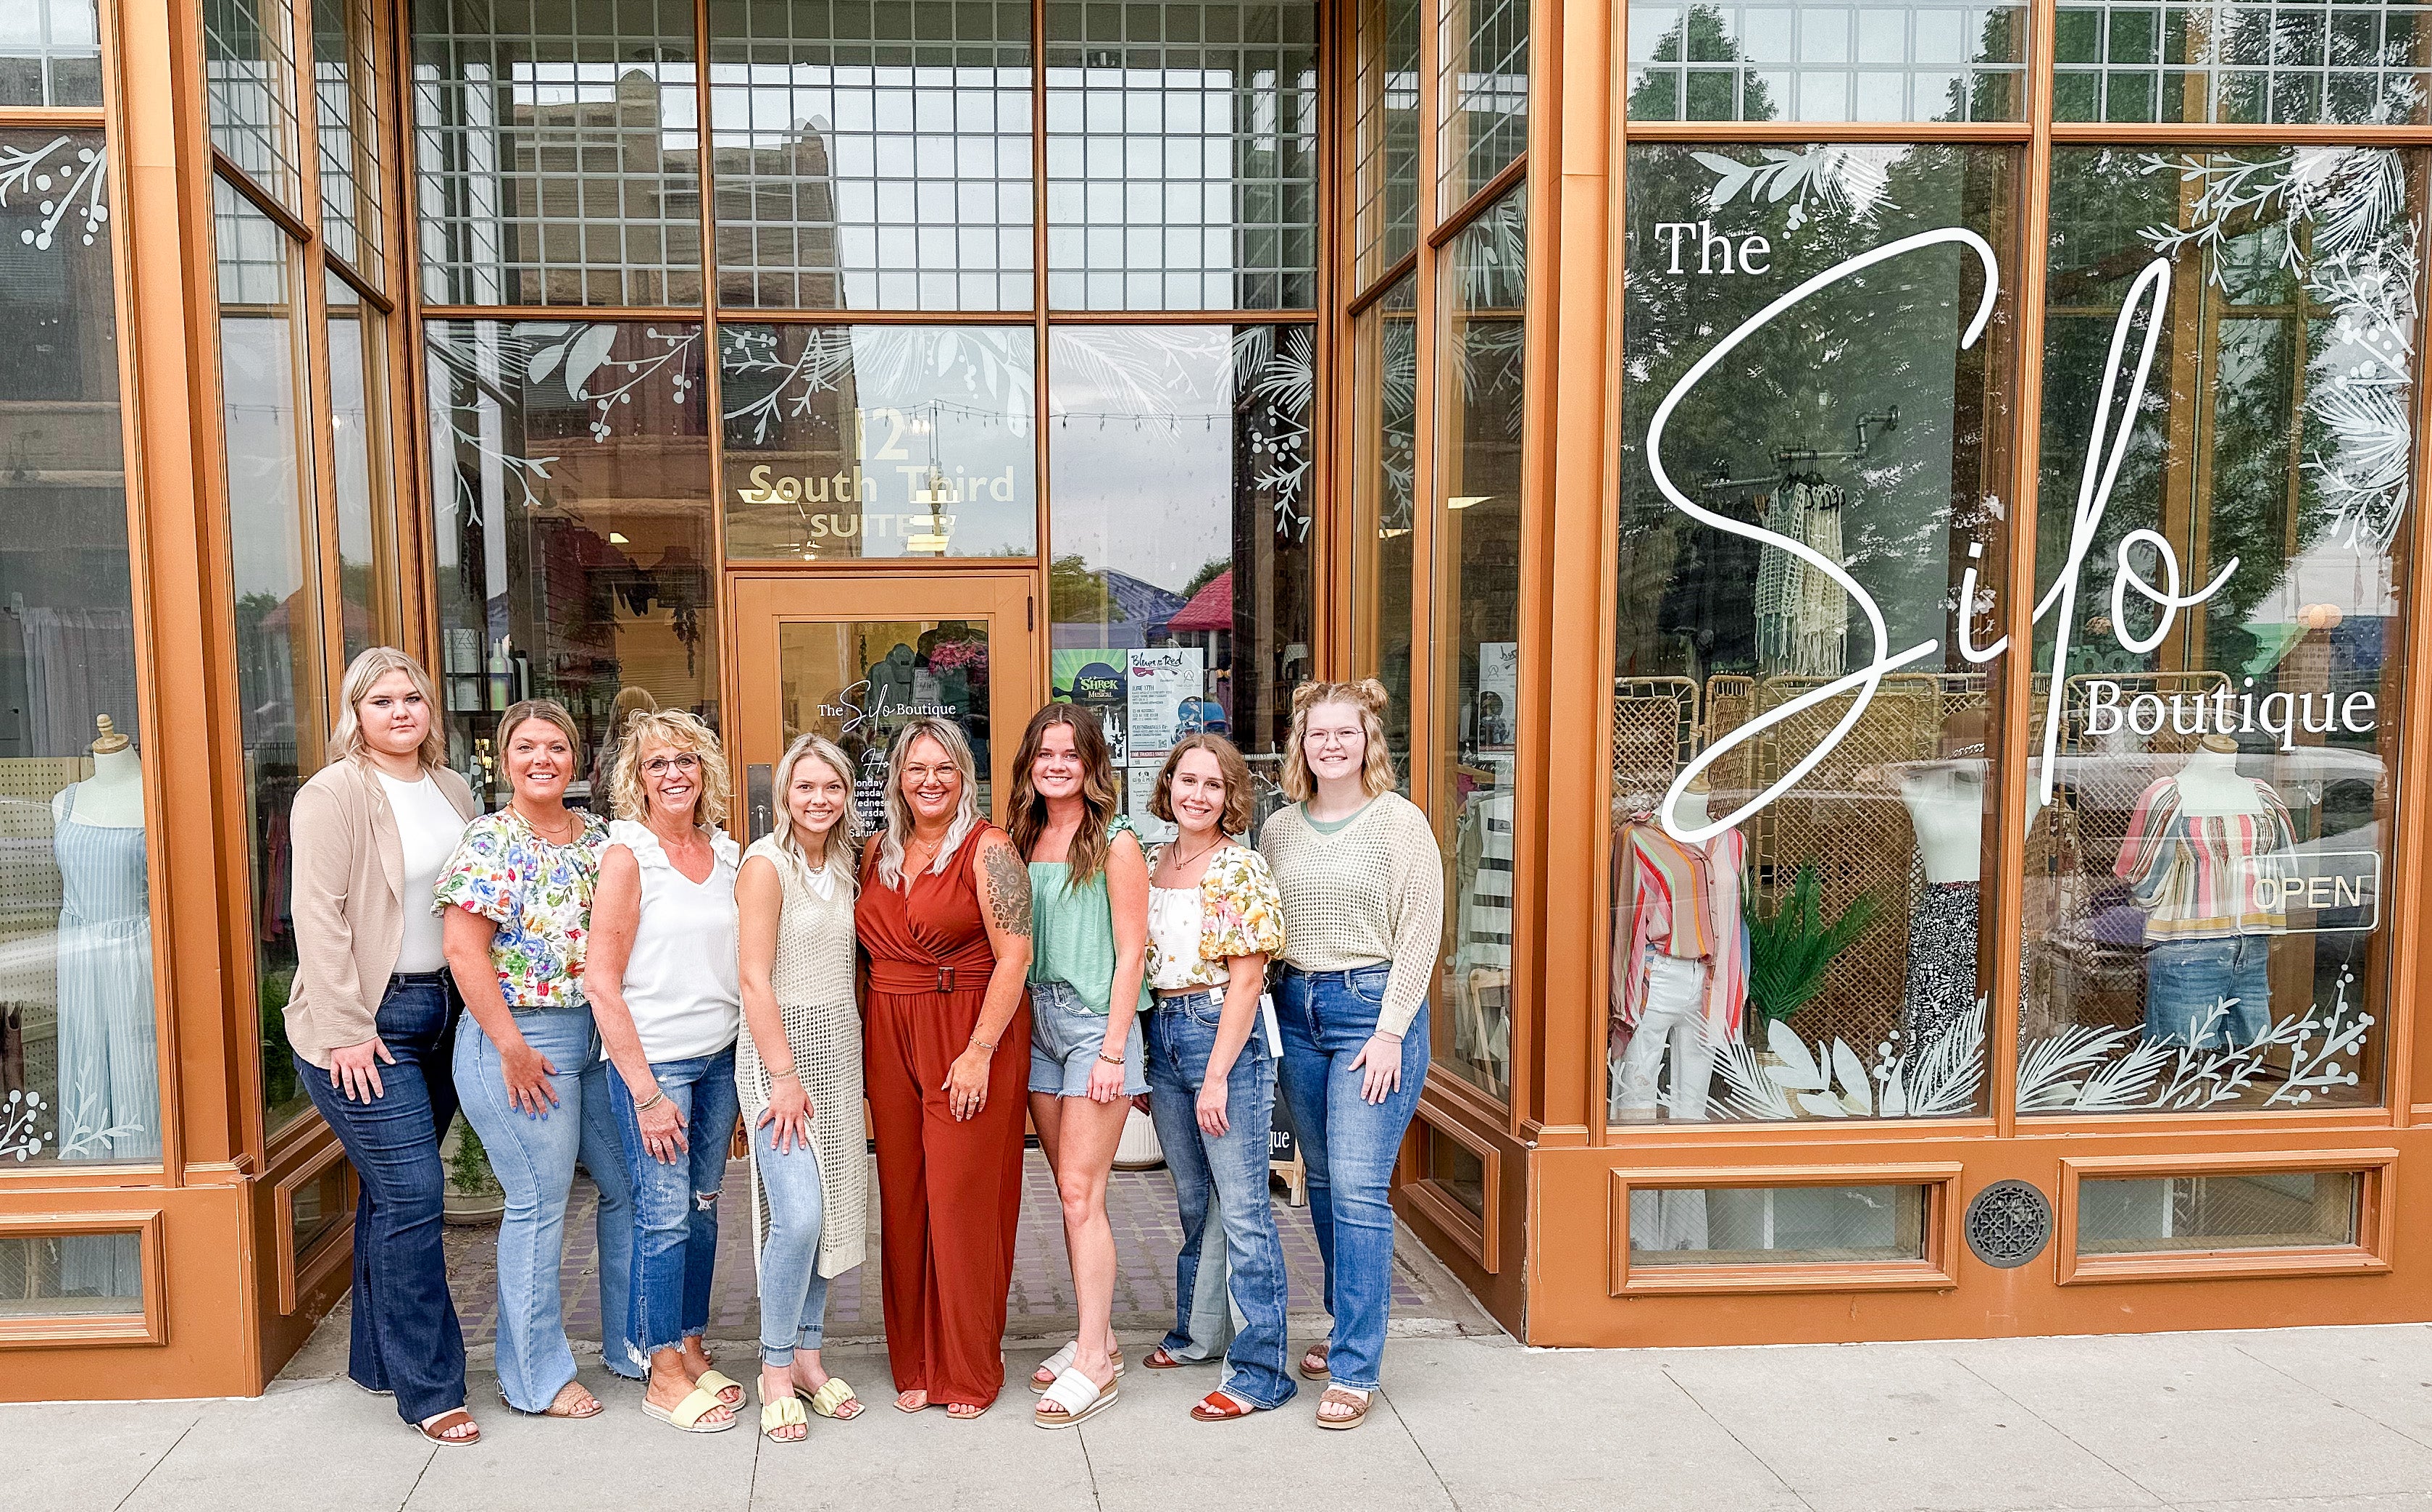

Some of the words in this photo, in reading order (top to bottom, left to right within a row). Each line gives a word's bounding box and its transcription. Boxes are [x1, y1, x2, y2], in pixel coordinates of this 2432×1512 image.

[1654, 219, 1770, 275] The
[855, 408, 909, 460] 12
[749, 465, 877, 503] South
[896, 465, 1014, 502] Third
[810, 513, 915, 538] SUITE
[1646, 227, 2240, 843] Silo
[817, 704, 843, 717] The
[840, 680, 896, 733] Silo
[896, 703, 957, 717] Boutique
[2083, 677, 2376, 751] Boutique
[854, 778, 884, 789] onday
[854, 788, 884, 799] uesday
[2252, 875, 2362, 910] OPEN
